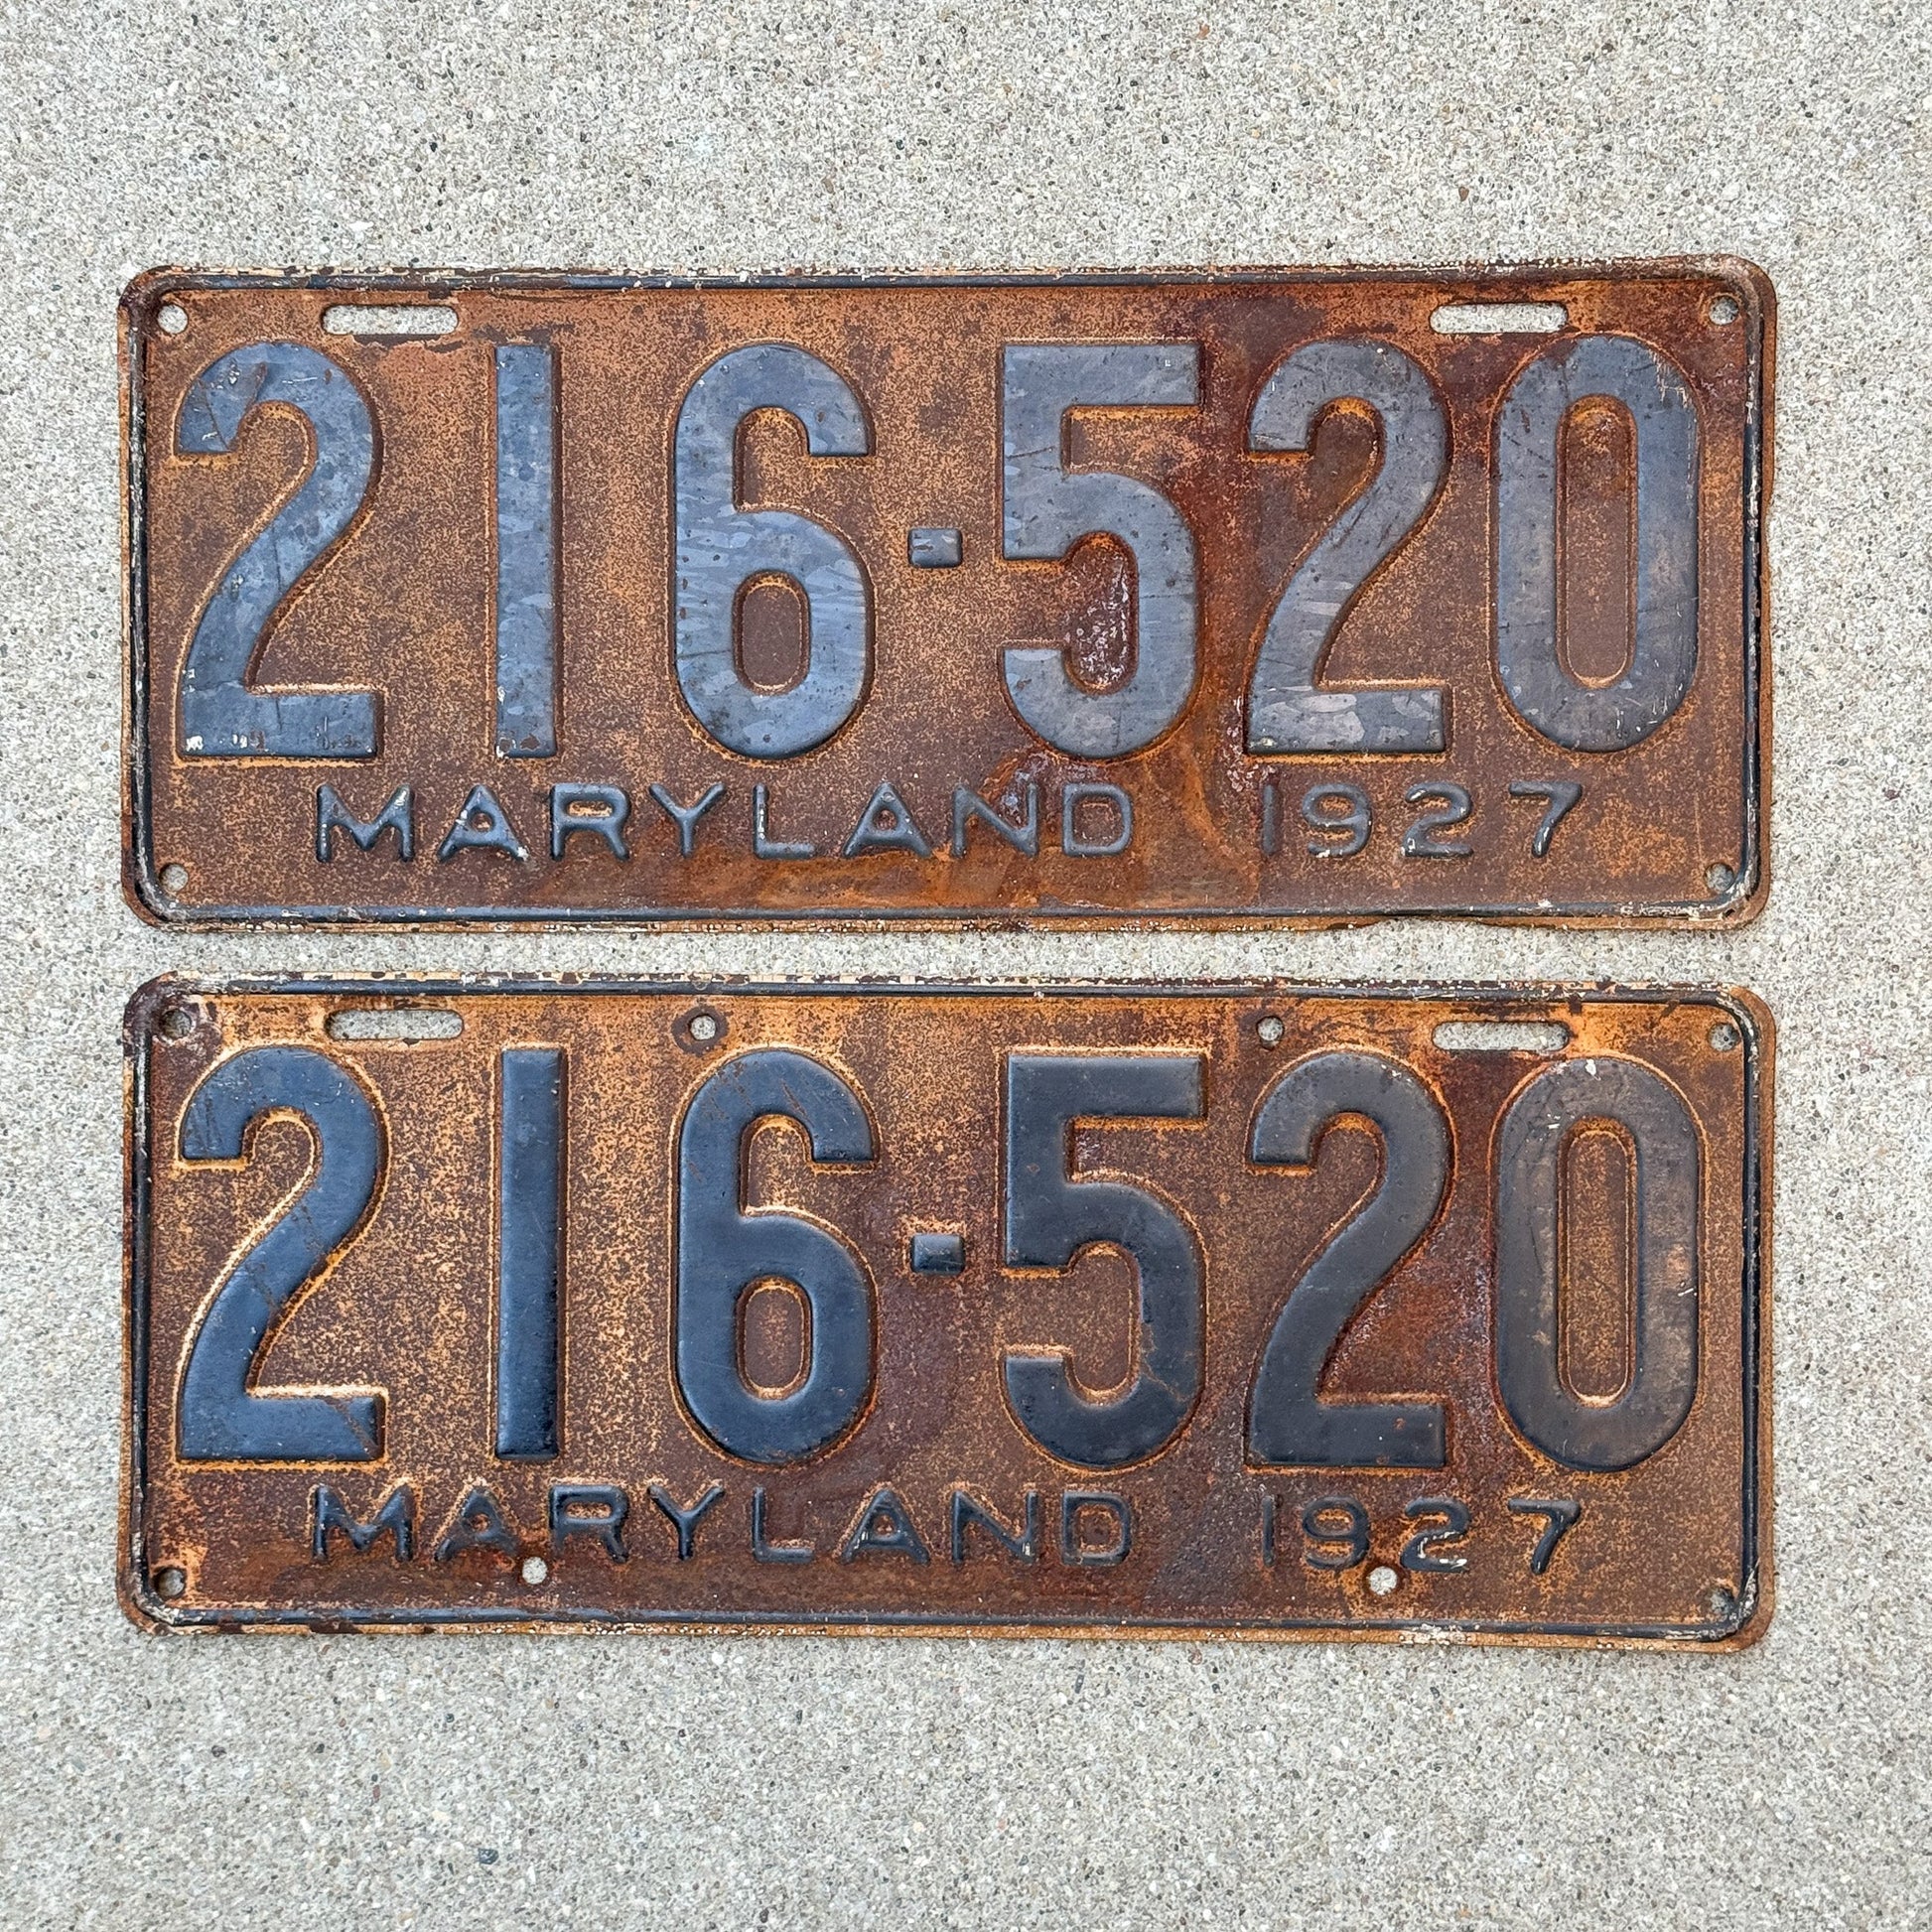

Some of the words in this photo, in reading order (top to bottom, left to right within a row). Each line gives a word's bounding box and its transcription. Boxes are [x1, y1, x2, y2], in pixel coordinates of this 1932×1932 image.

[177, 336, 1702, 759] 216-520
[317, 781, 1134, 865] MARYLAND
[1260, 782, 1583, 860] 1927
[177, 1047, 1702, 1471] 216-520
[314, 1483, 1133, 1566] MARYLAND
[1260, 1495, 1583, 1575] 1927
